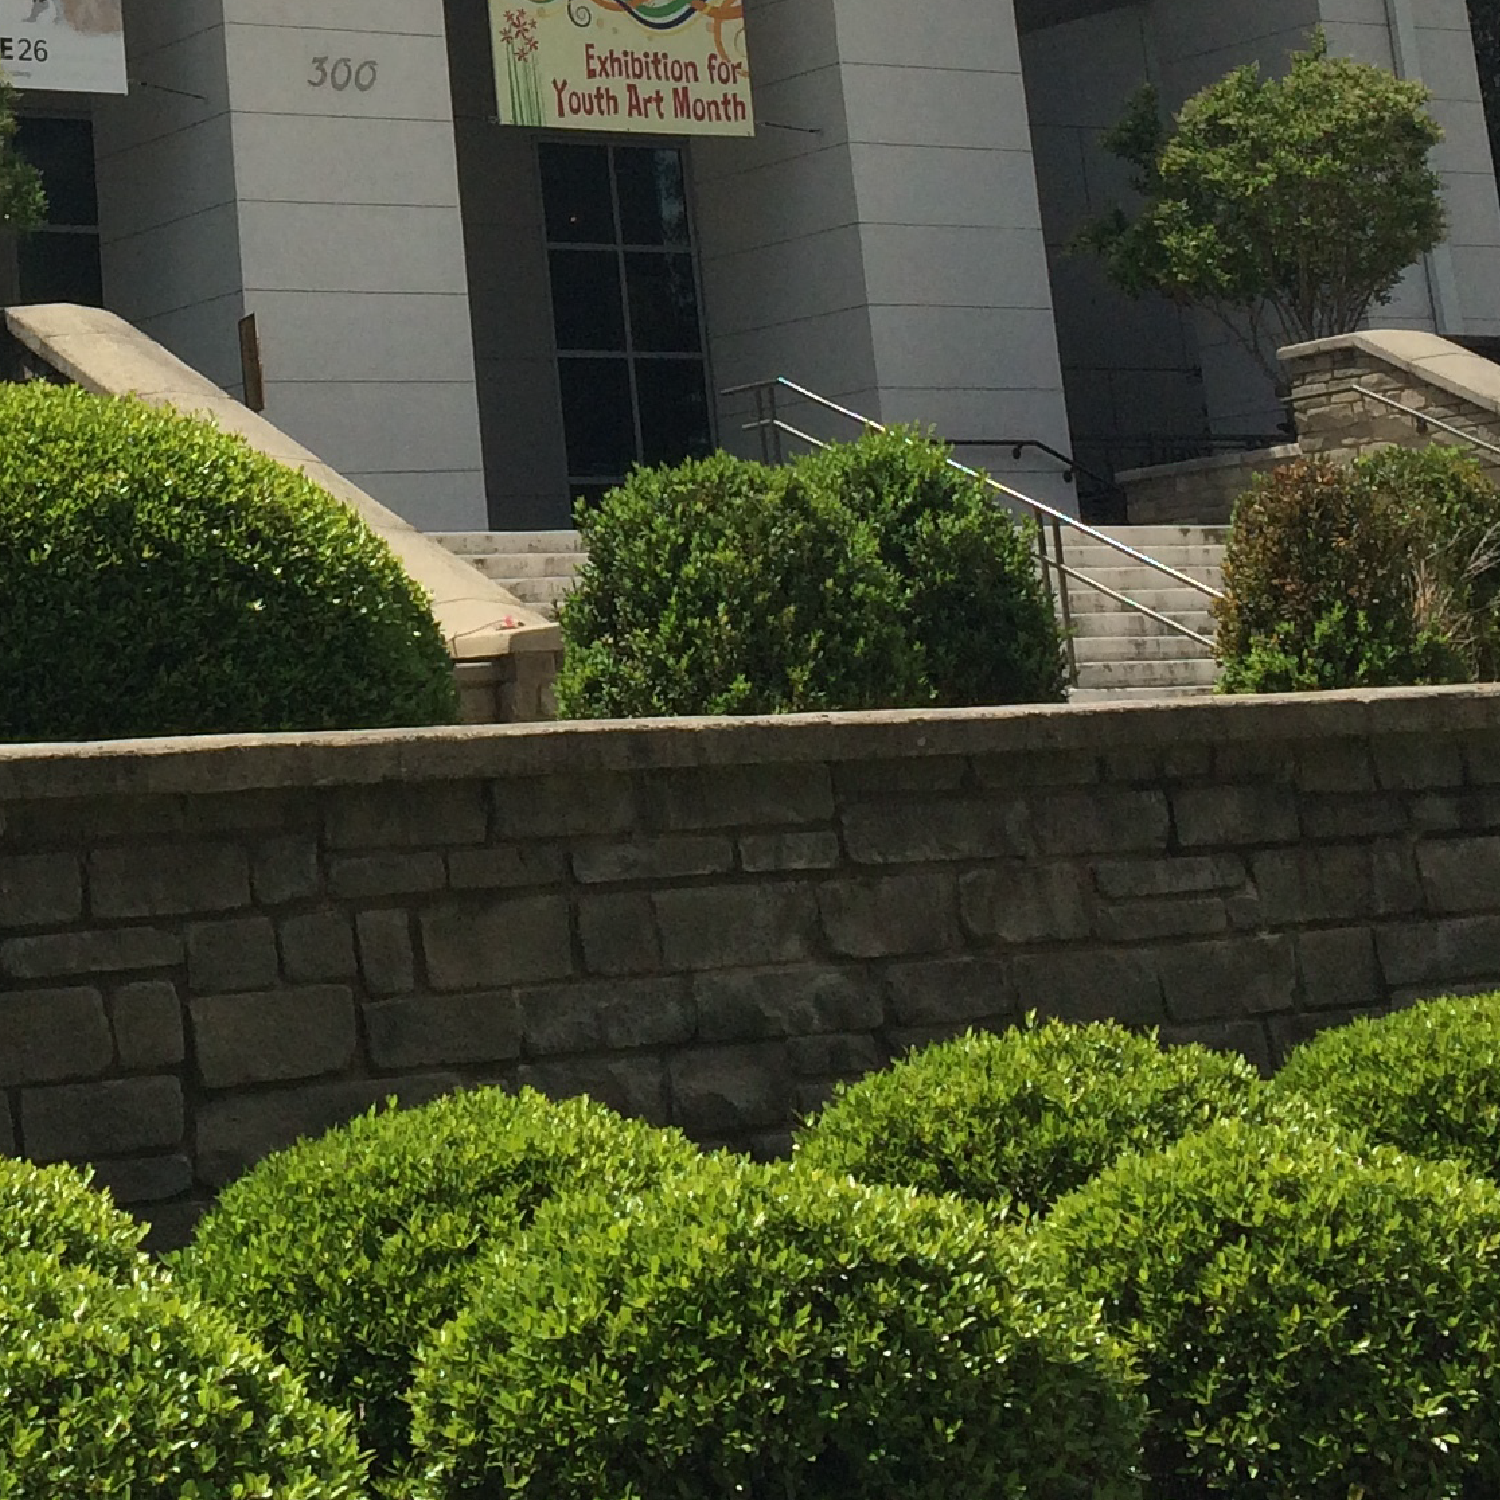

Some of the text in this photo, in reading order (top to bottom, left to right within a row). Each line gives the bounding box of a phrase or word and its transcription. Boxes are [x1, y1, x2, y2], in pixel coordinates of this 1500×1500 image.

[307, 56, 378, 92] 300
[585, 43, 741, 85] Exhibition for
[551, 78, 746, 122] Youth Art Month
